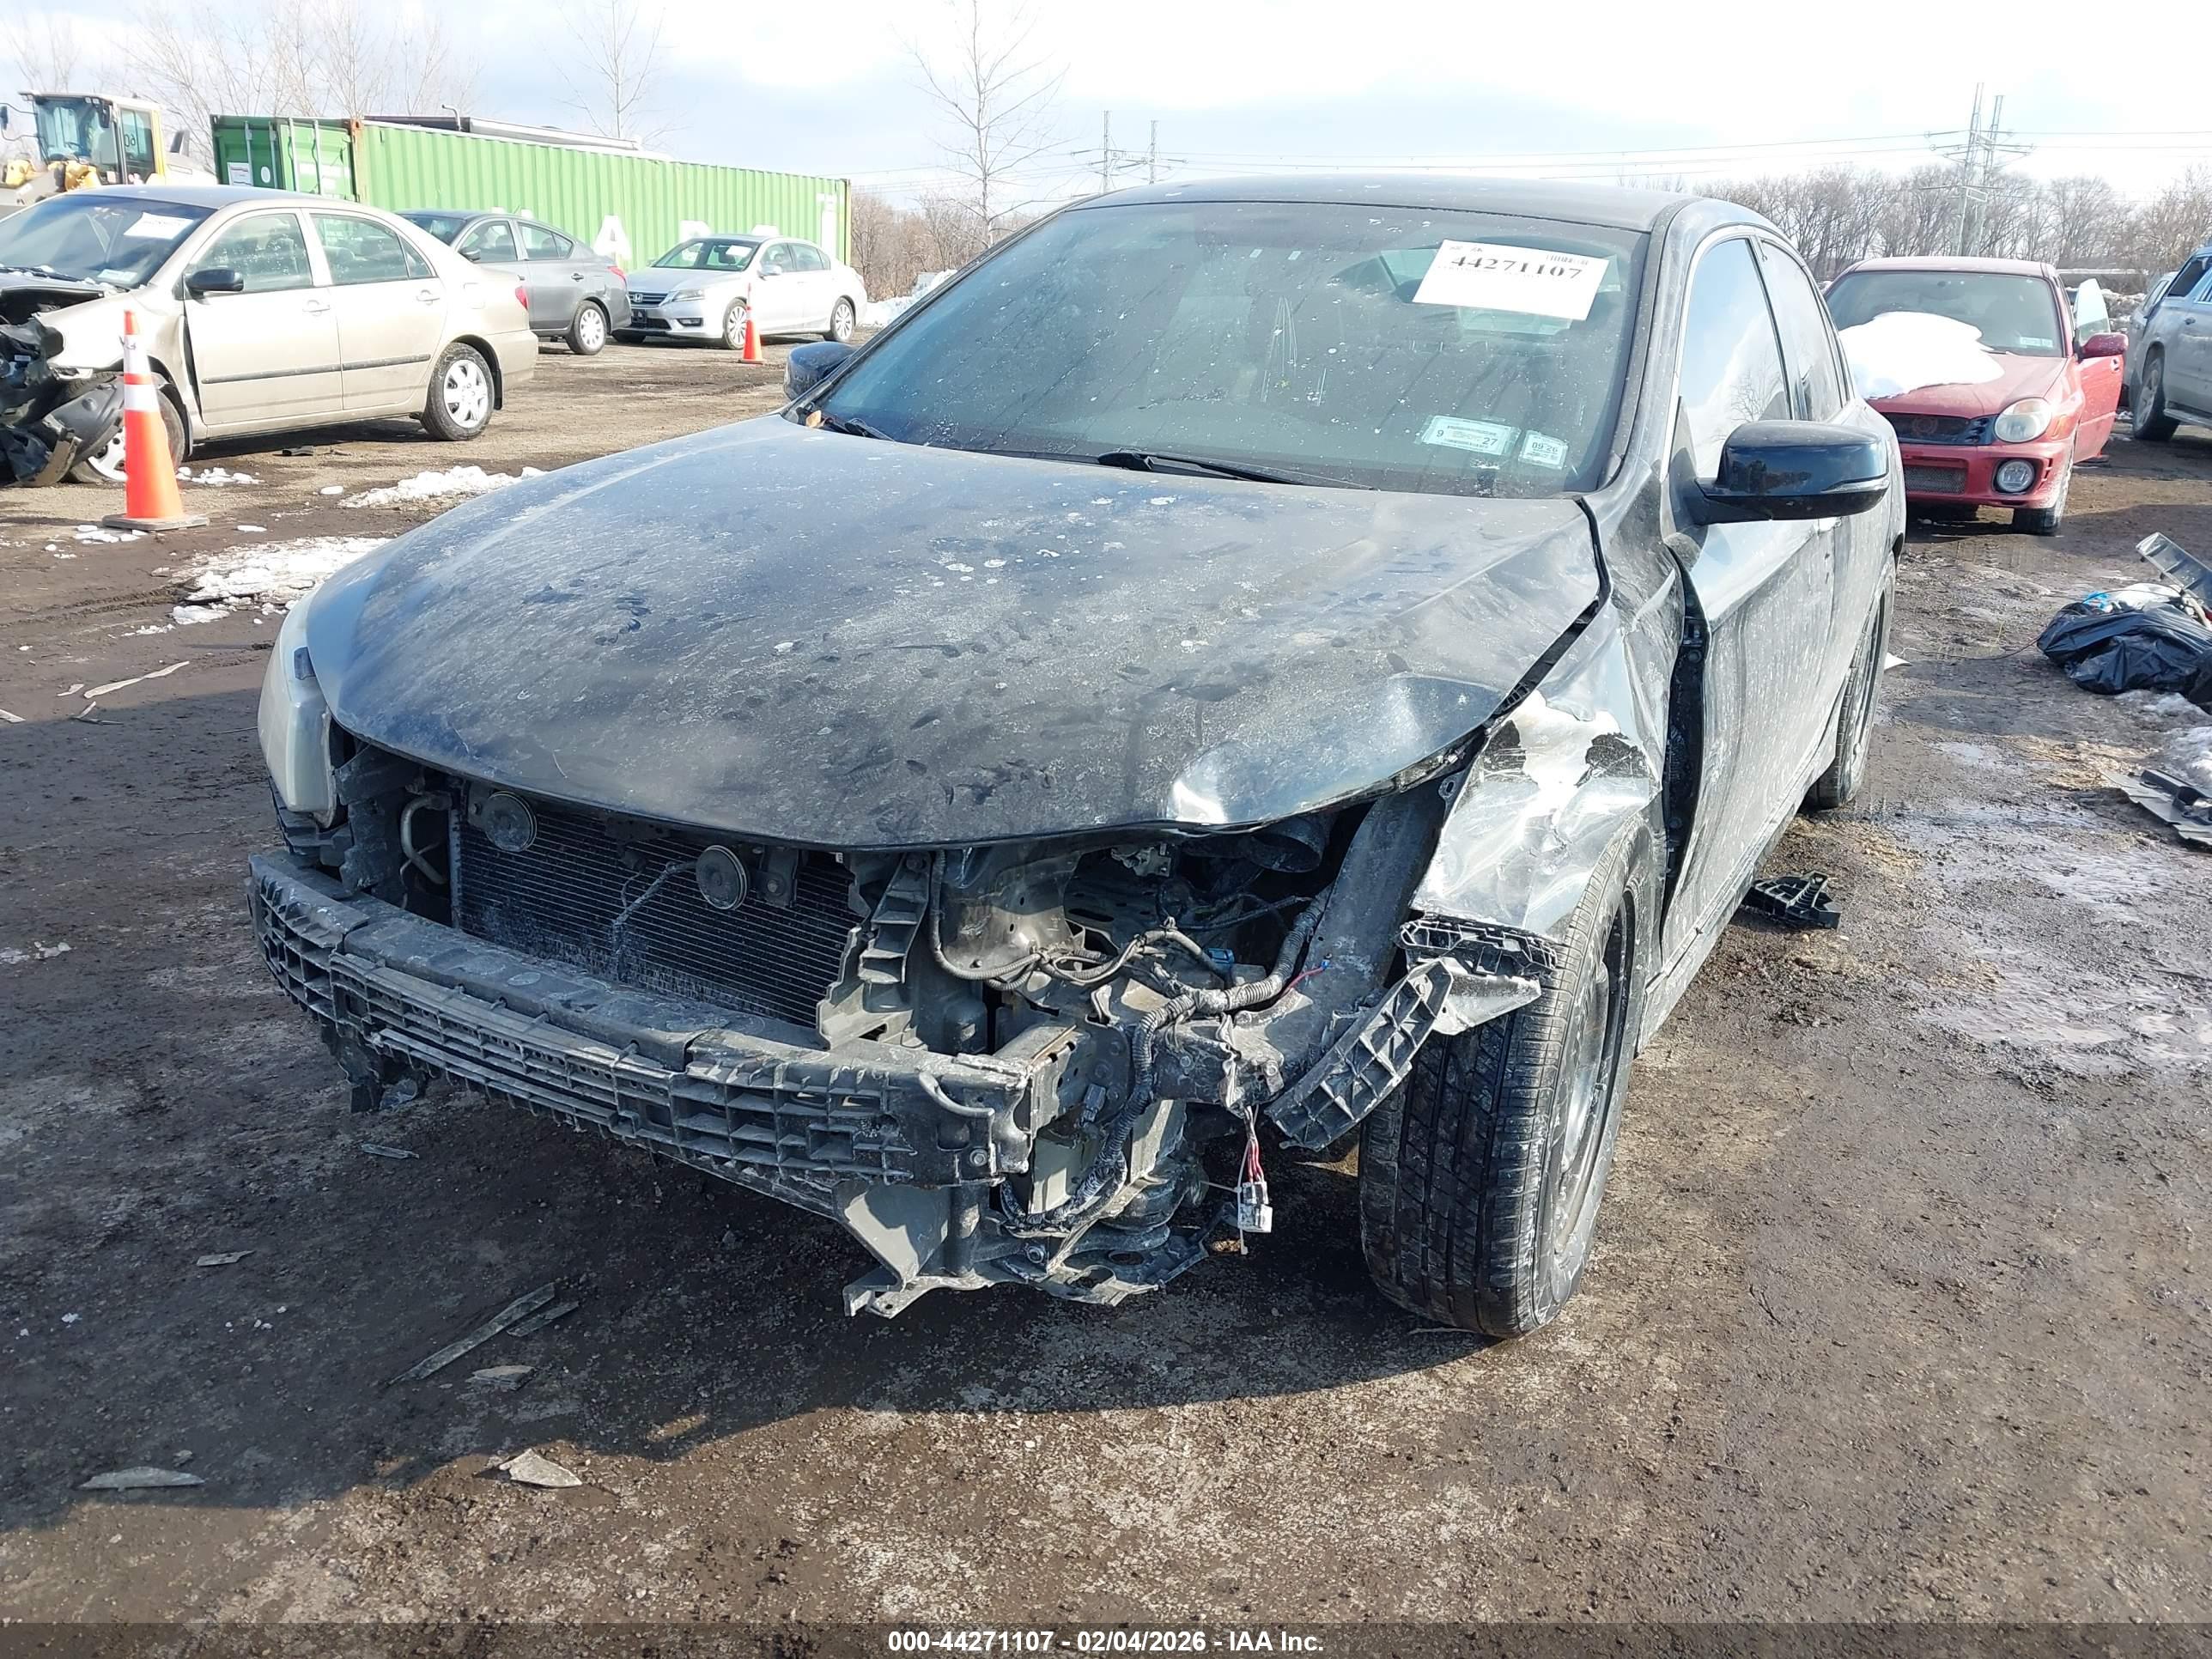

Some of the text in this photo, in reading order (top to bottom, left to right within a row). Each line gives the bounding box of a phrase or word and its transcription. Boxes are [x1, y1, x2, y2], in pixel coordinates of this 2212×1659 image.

[1450, 255, 1583, 280] 44271107
[1436, 429, 1444, 438] 9
[1482, 436, 1498, 447] 27
